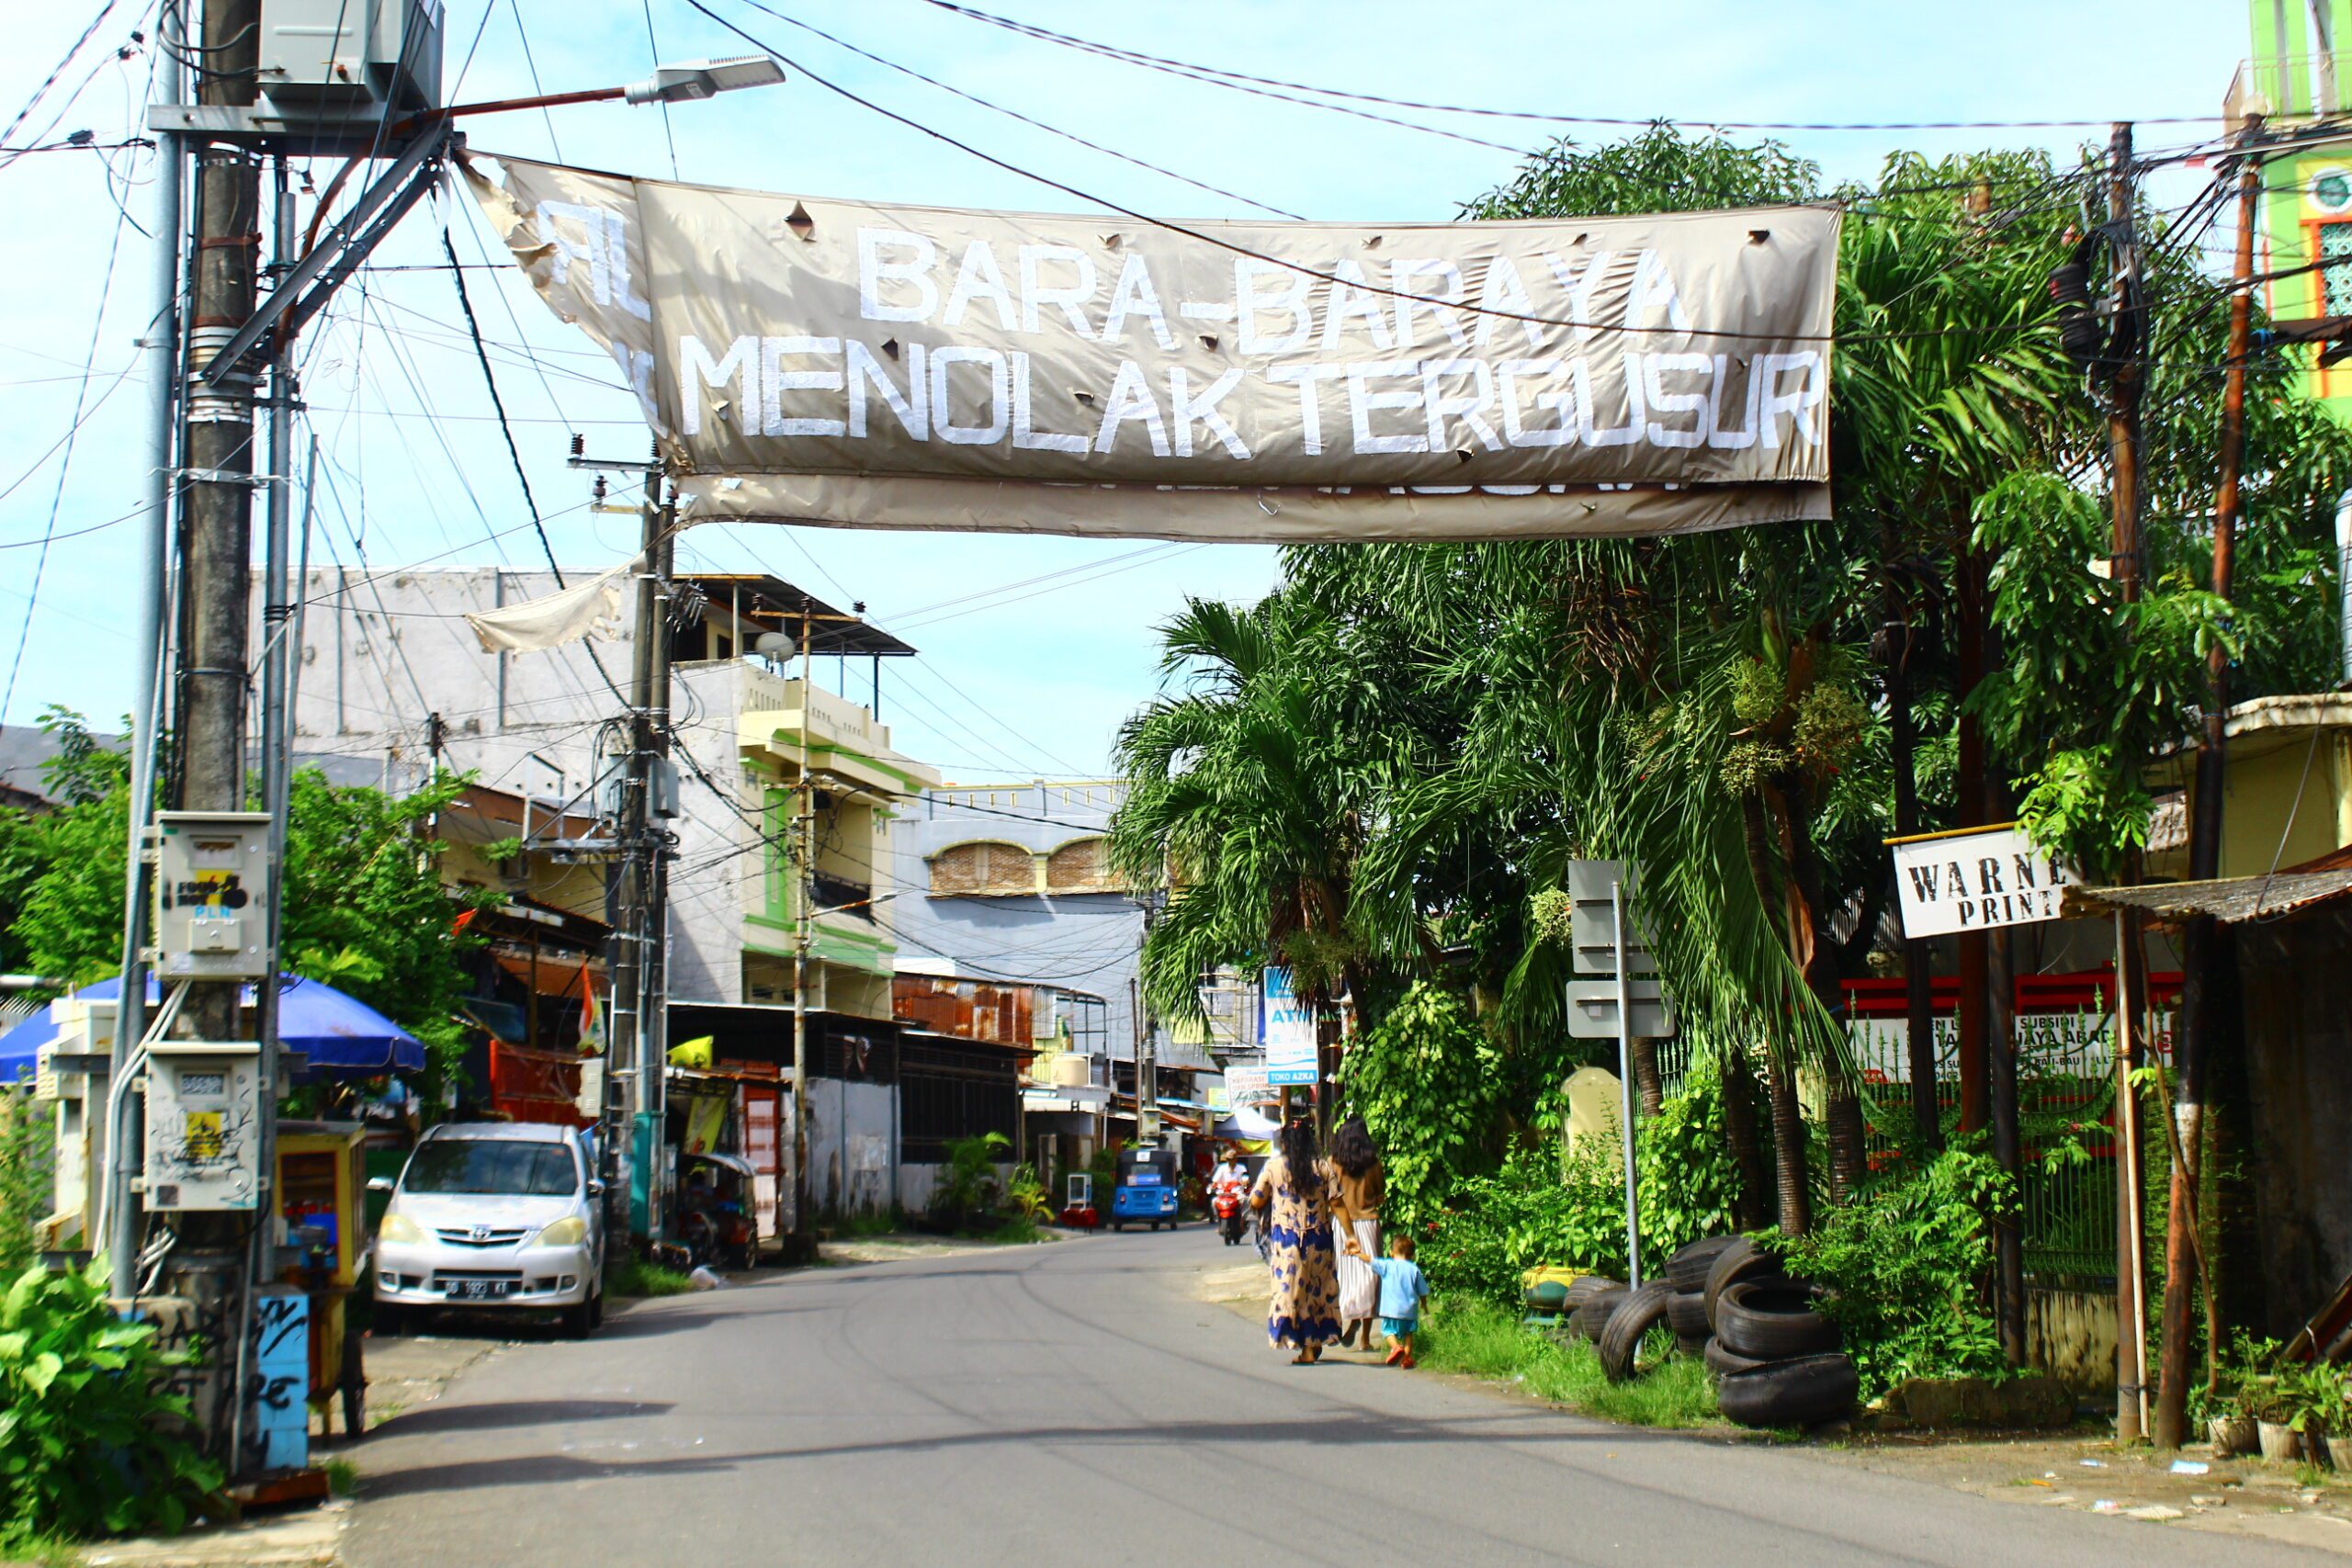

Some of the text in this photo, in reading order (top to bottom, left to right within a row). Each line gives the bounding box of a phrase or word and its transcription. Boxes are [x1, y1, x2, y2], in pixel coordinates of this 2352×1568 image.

[858, 226, 1692, 356] BARA-BARAYA
[679, 334, 1252, 459] MENOLAK
[1266, 350, 1824, 457] TERGUSUR
[195, 906, 230, 918] PLN
[1271, 1072, 1291, 1082] TOKO
[1293, 1071, 1315, 1081] AZKA
